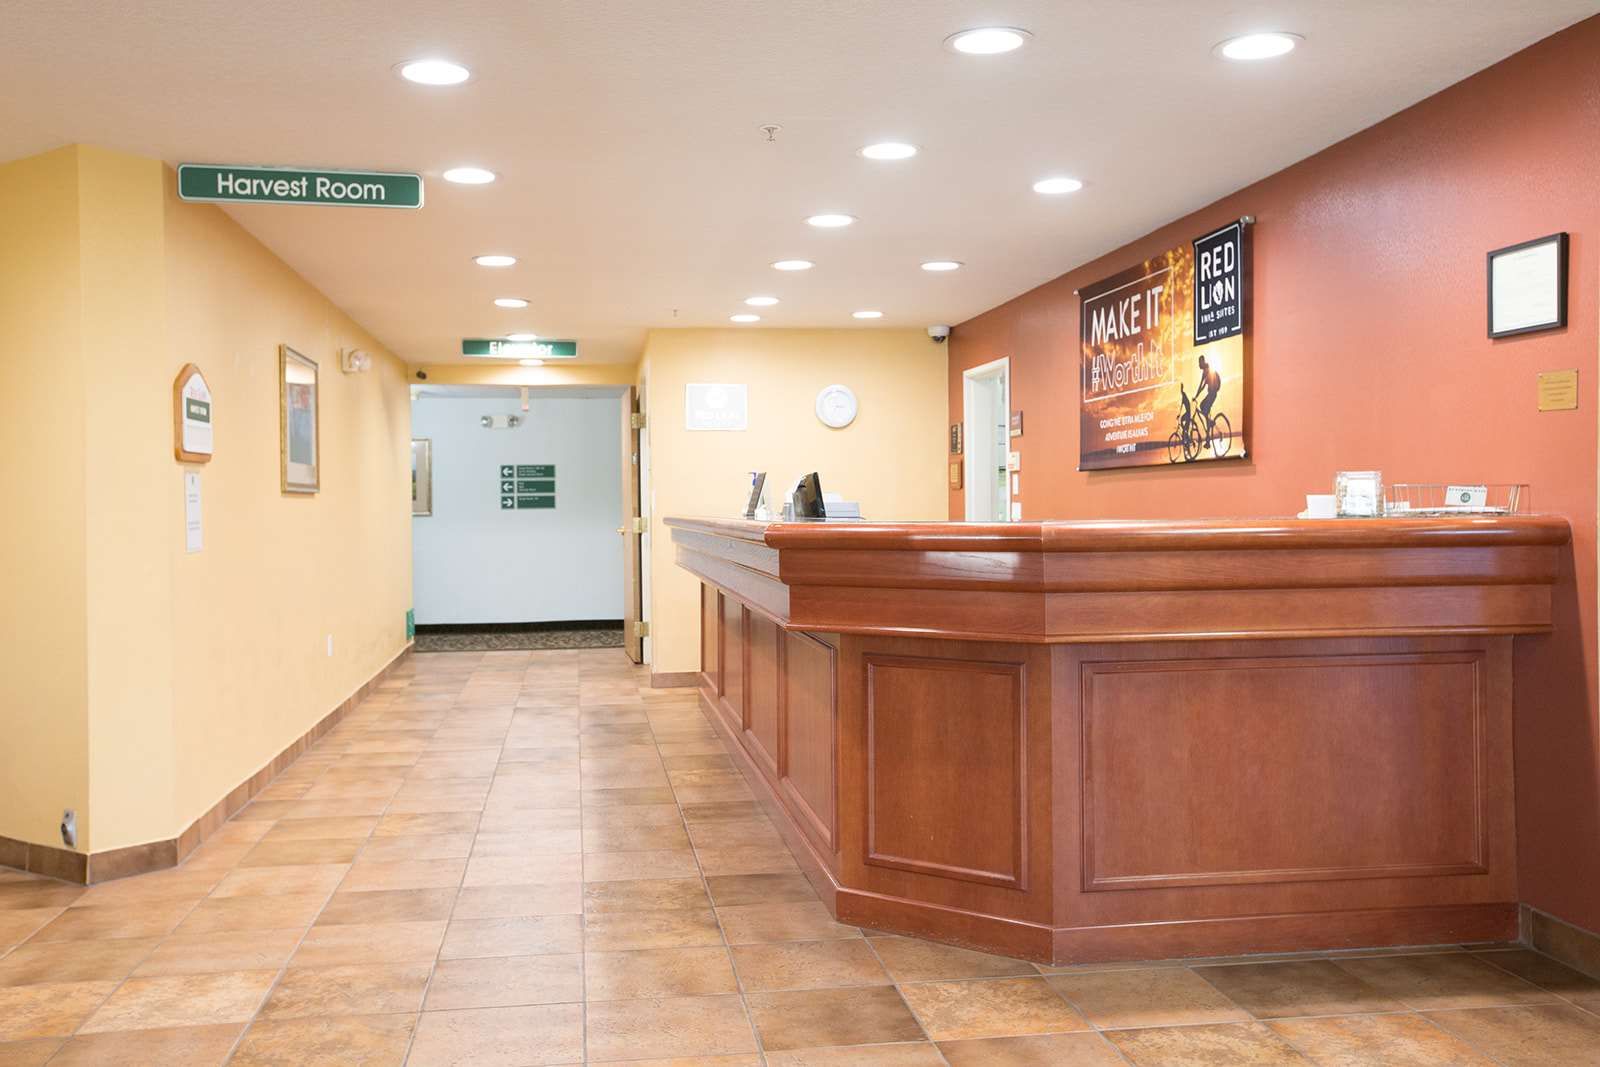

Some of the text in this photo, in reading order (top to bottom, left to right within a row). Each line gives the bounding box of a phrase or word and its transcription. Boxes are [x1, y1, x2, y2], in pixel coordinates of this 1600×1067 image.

[216, 172, 386, 201] Harvest Room
[1200, 241, 1235, 282] RED
[1200, 275, 1235, 311] LION
[1091, 285, 1164, 348] MAKE IT
